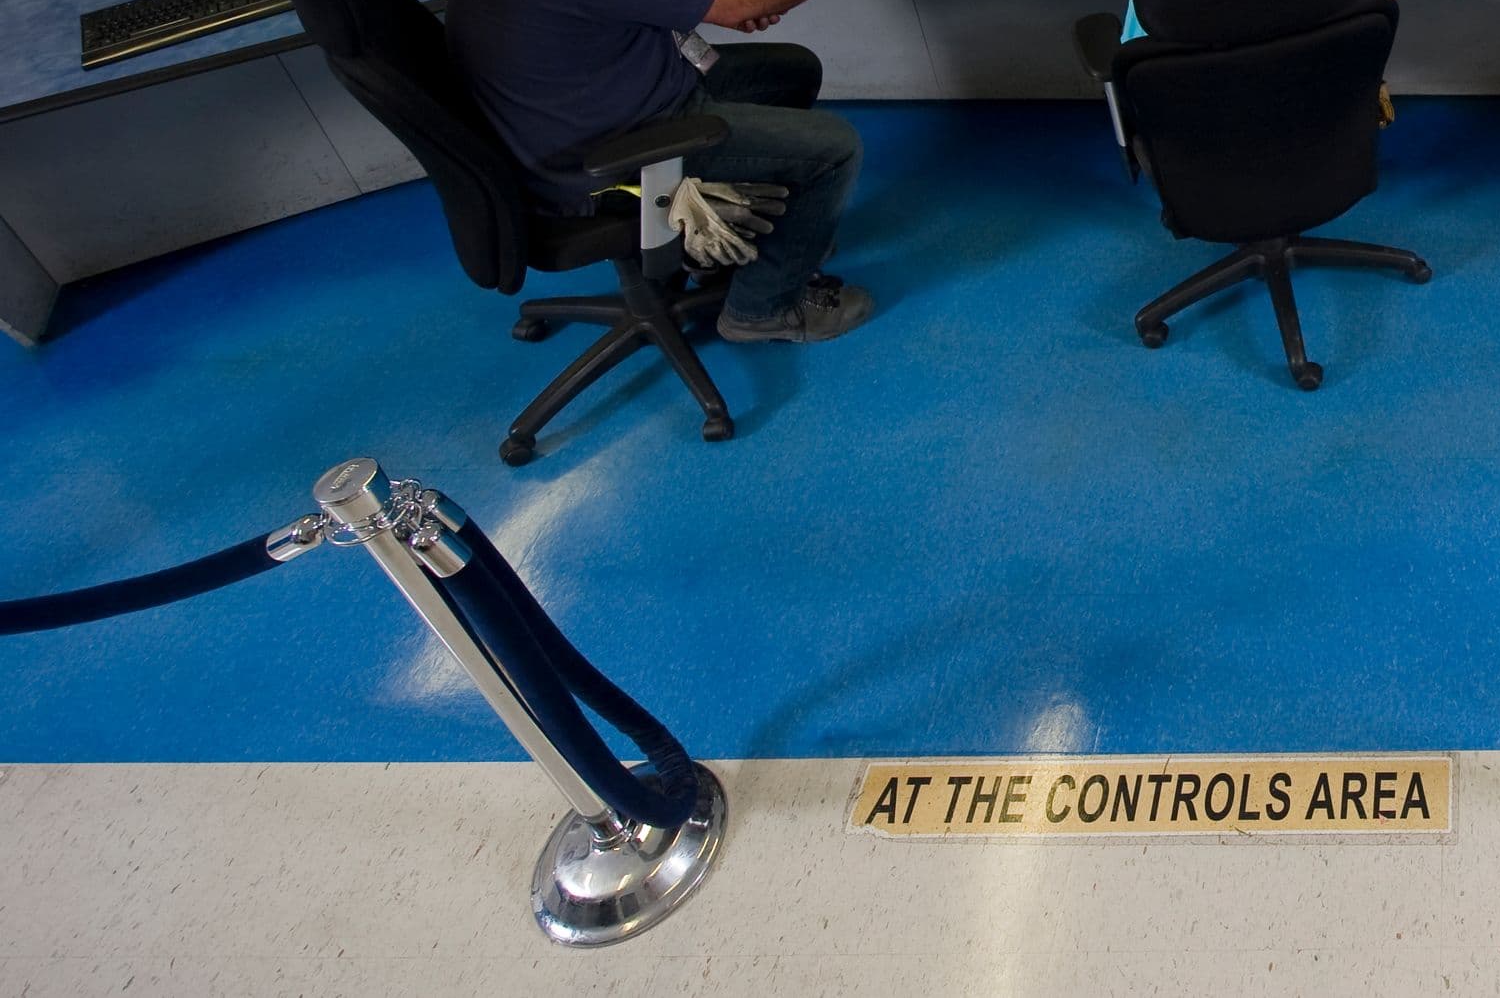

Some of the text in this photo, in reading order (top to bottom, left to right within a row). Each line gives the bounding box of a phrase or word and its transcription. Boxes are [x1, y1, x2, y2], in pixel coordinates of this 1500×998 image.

[865, 771, 1431, 825] AT THE CONTROLS AREA
